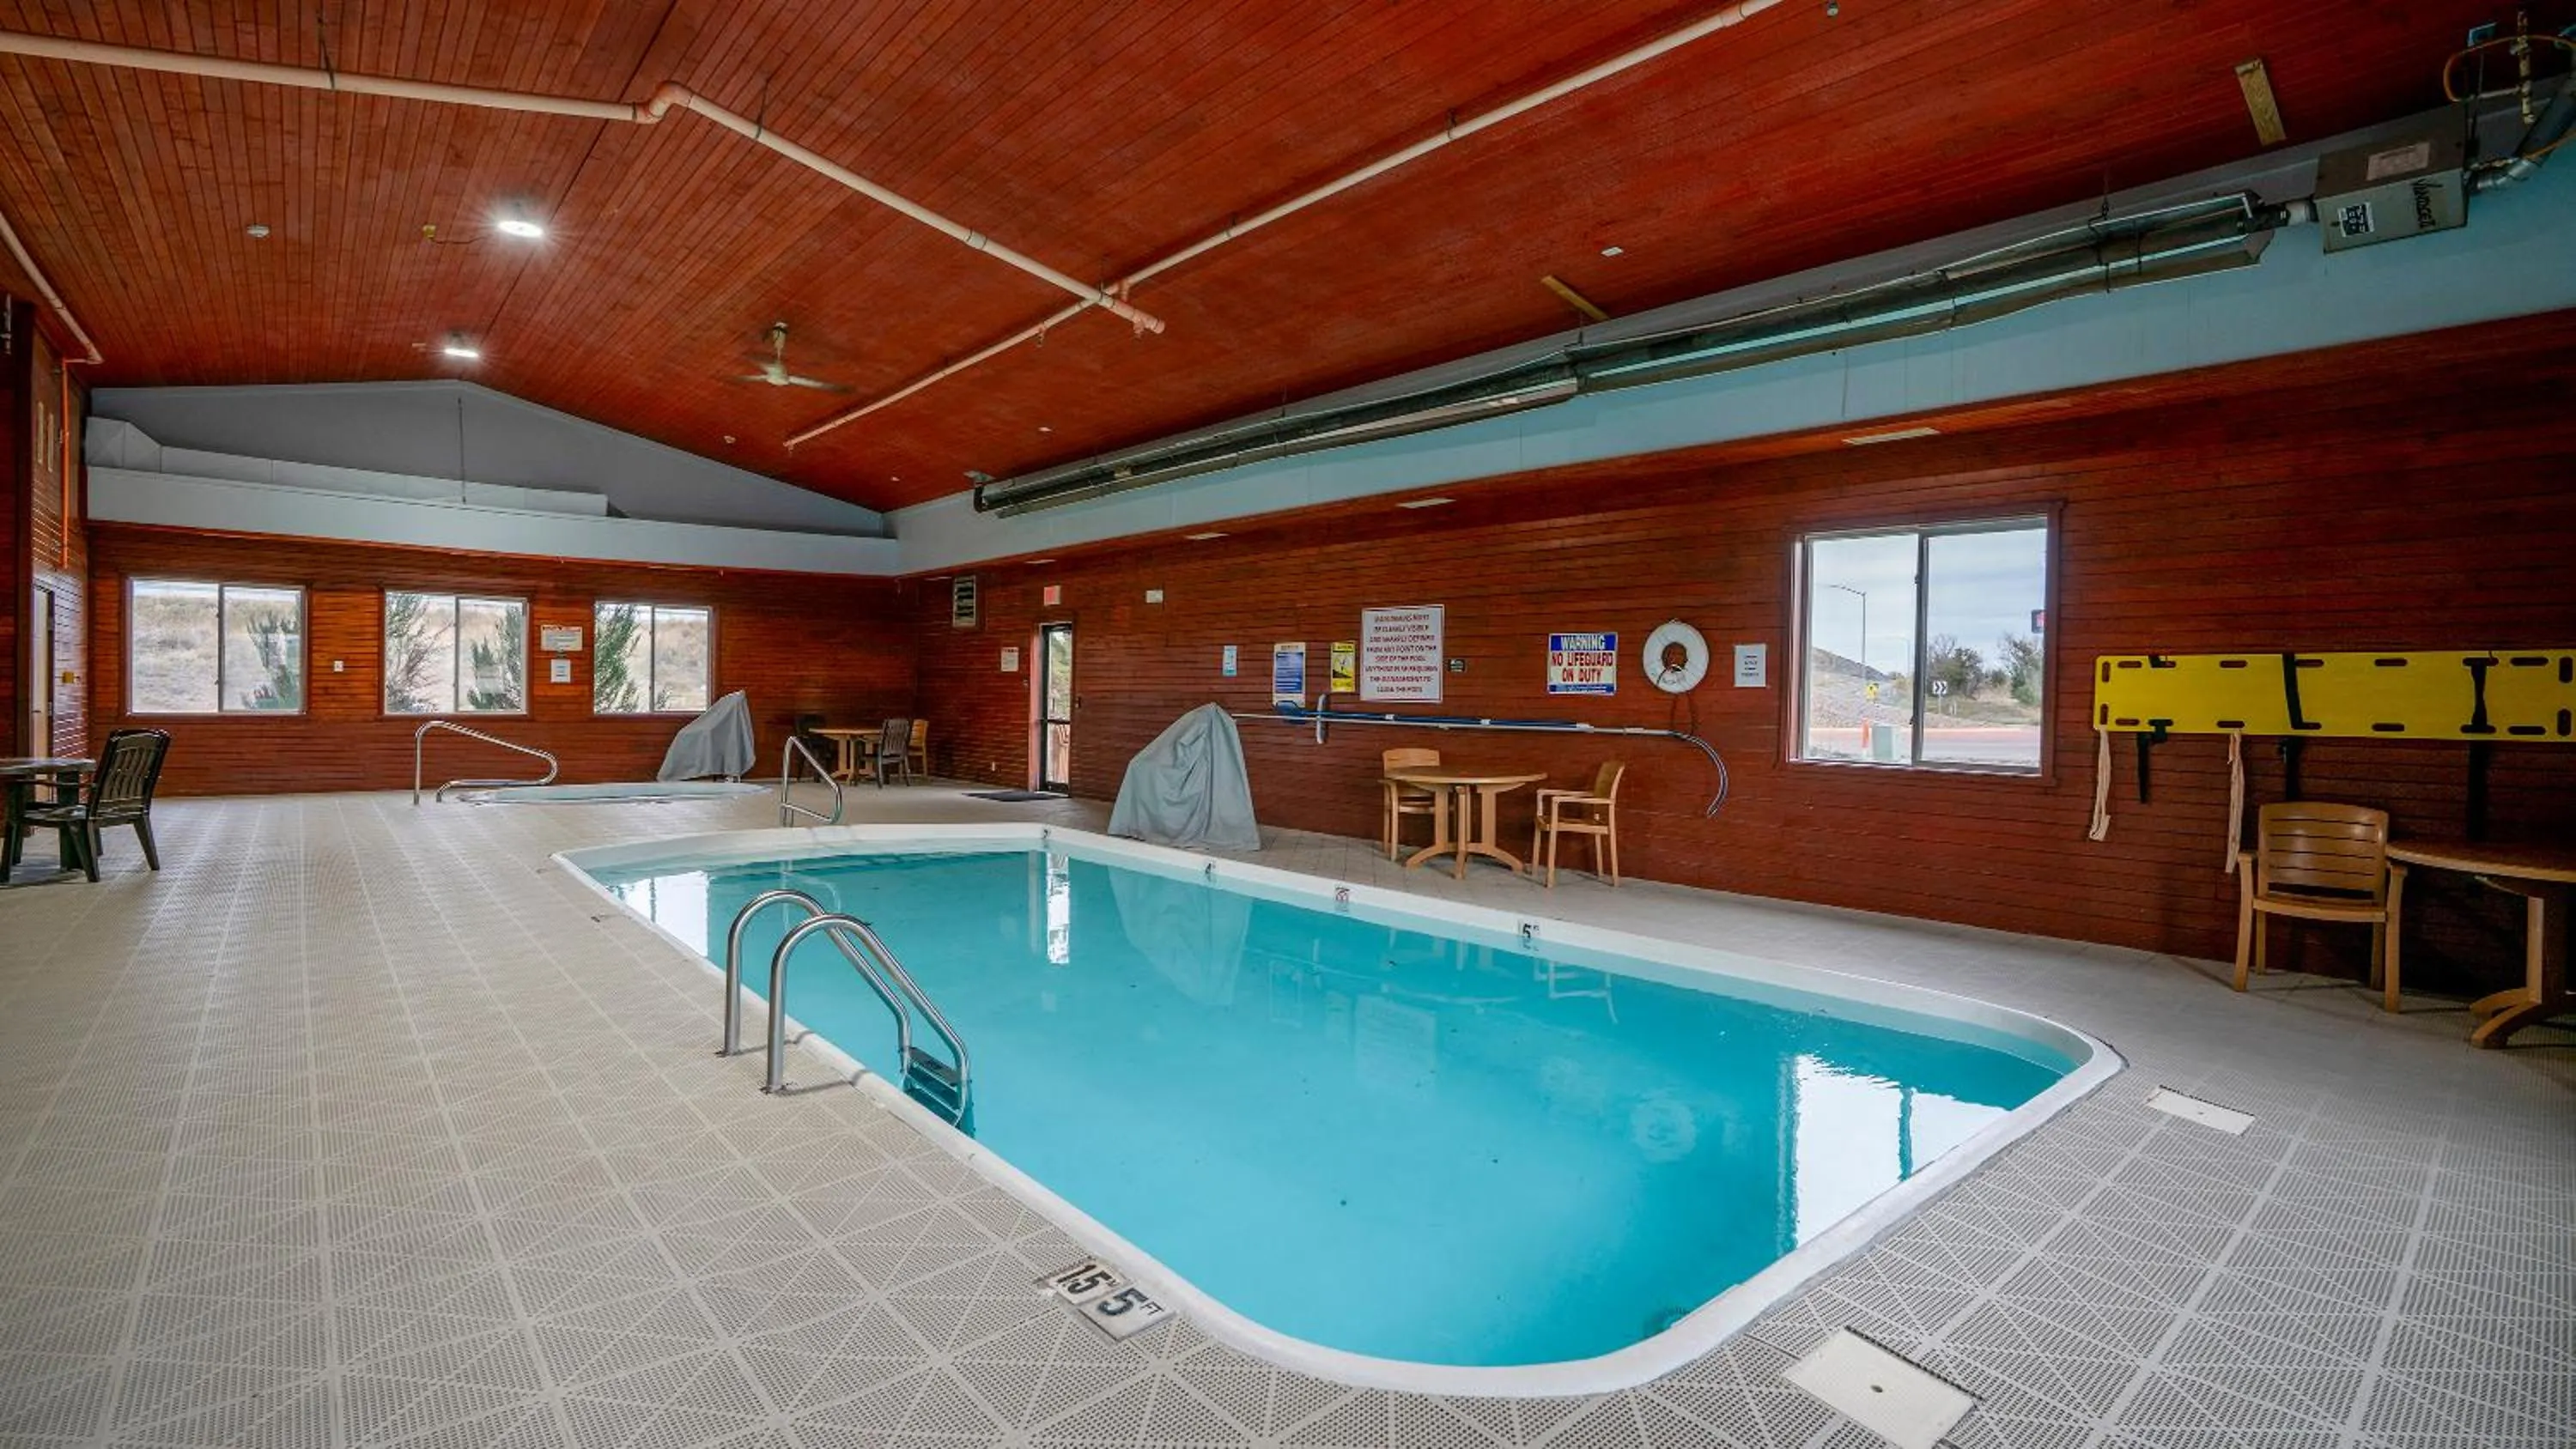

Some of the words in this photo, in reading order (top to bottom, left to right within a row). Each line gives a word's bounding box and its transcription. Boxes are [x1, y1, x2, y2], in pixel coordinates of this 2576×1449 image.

[1561, 635, 1606, 650] WARNING
[1552, 652, 1564, 666] NO
[1567, 652, 1613, 666] LIFEGUARD
[1562, 668, 1574, 682] ON
[1578, 668, 1602, 682] DUTY
